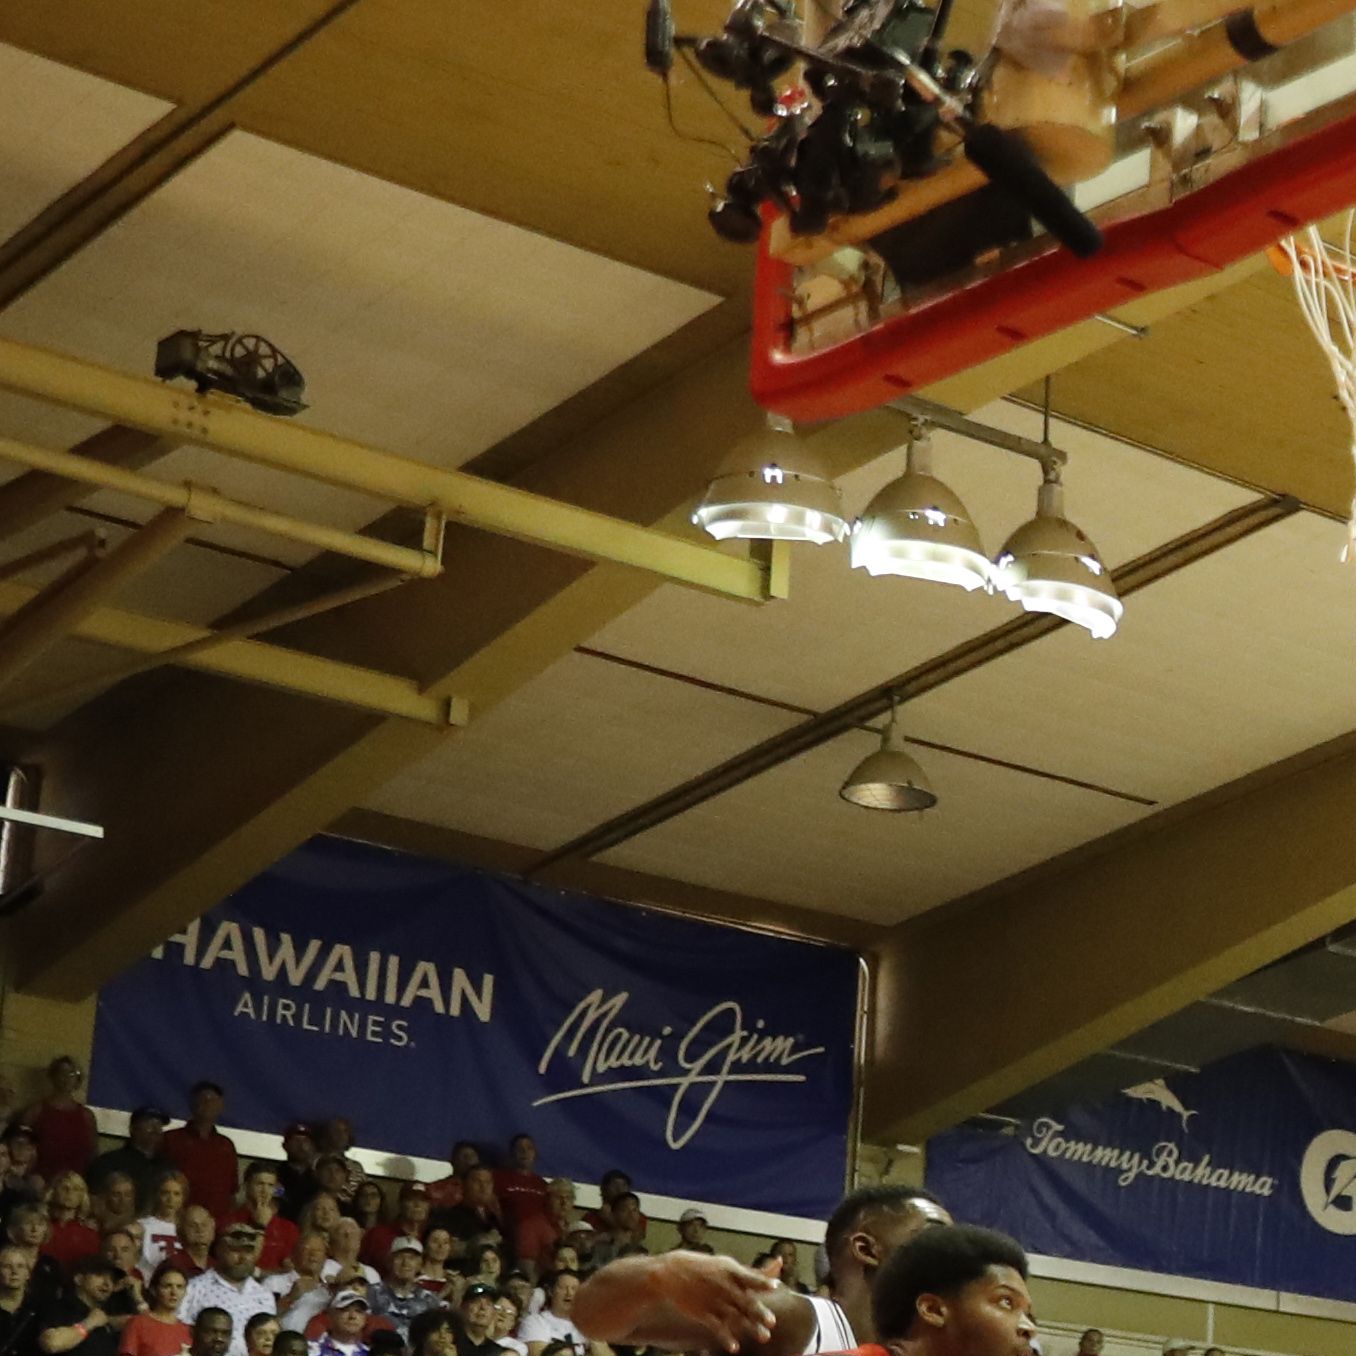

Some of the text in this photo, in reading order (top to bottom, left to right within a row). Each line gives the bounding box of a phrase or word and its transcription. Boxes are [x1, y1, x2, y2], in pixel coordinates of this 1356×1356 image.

[151, 916, 497, 1023] HAWAIIAN
[234, 990, 412, 1048] AIRLINES
[538, 988, 826, 1150] Maui Jim
[1026, 1116, 1278, 1198] Tommy Bahama
